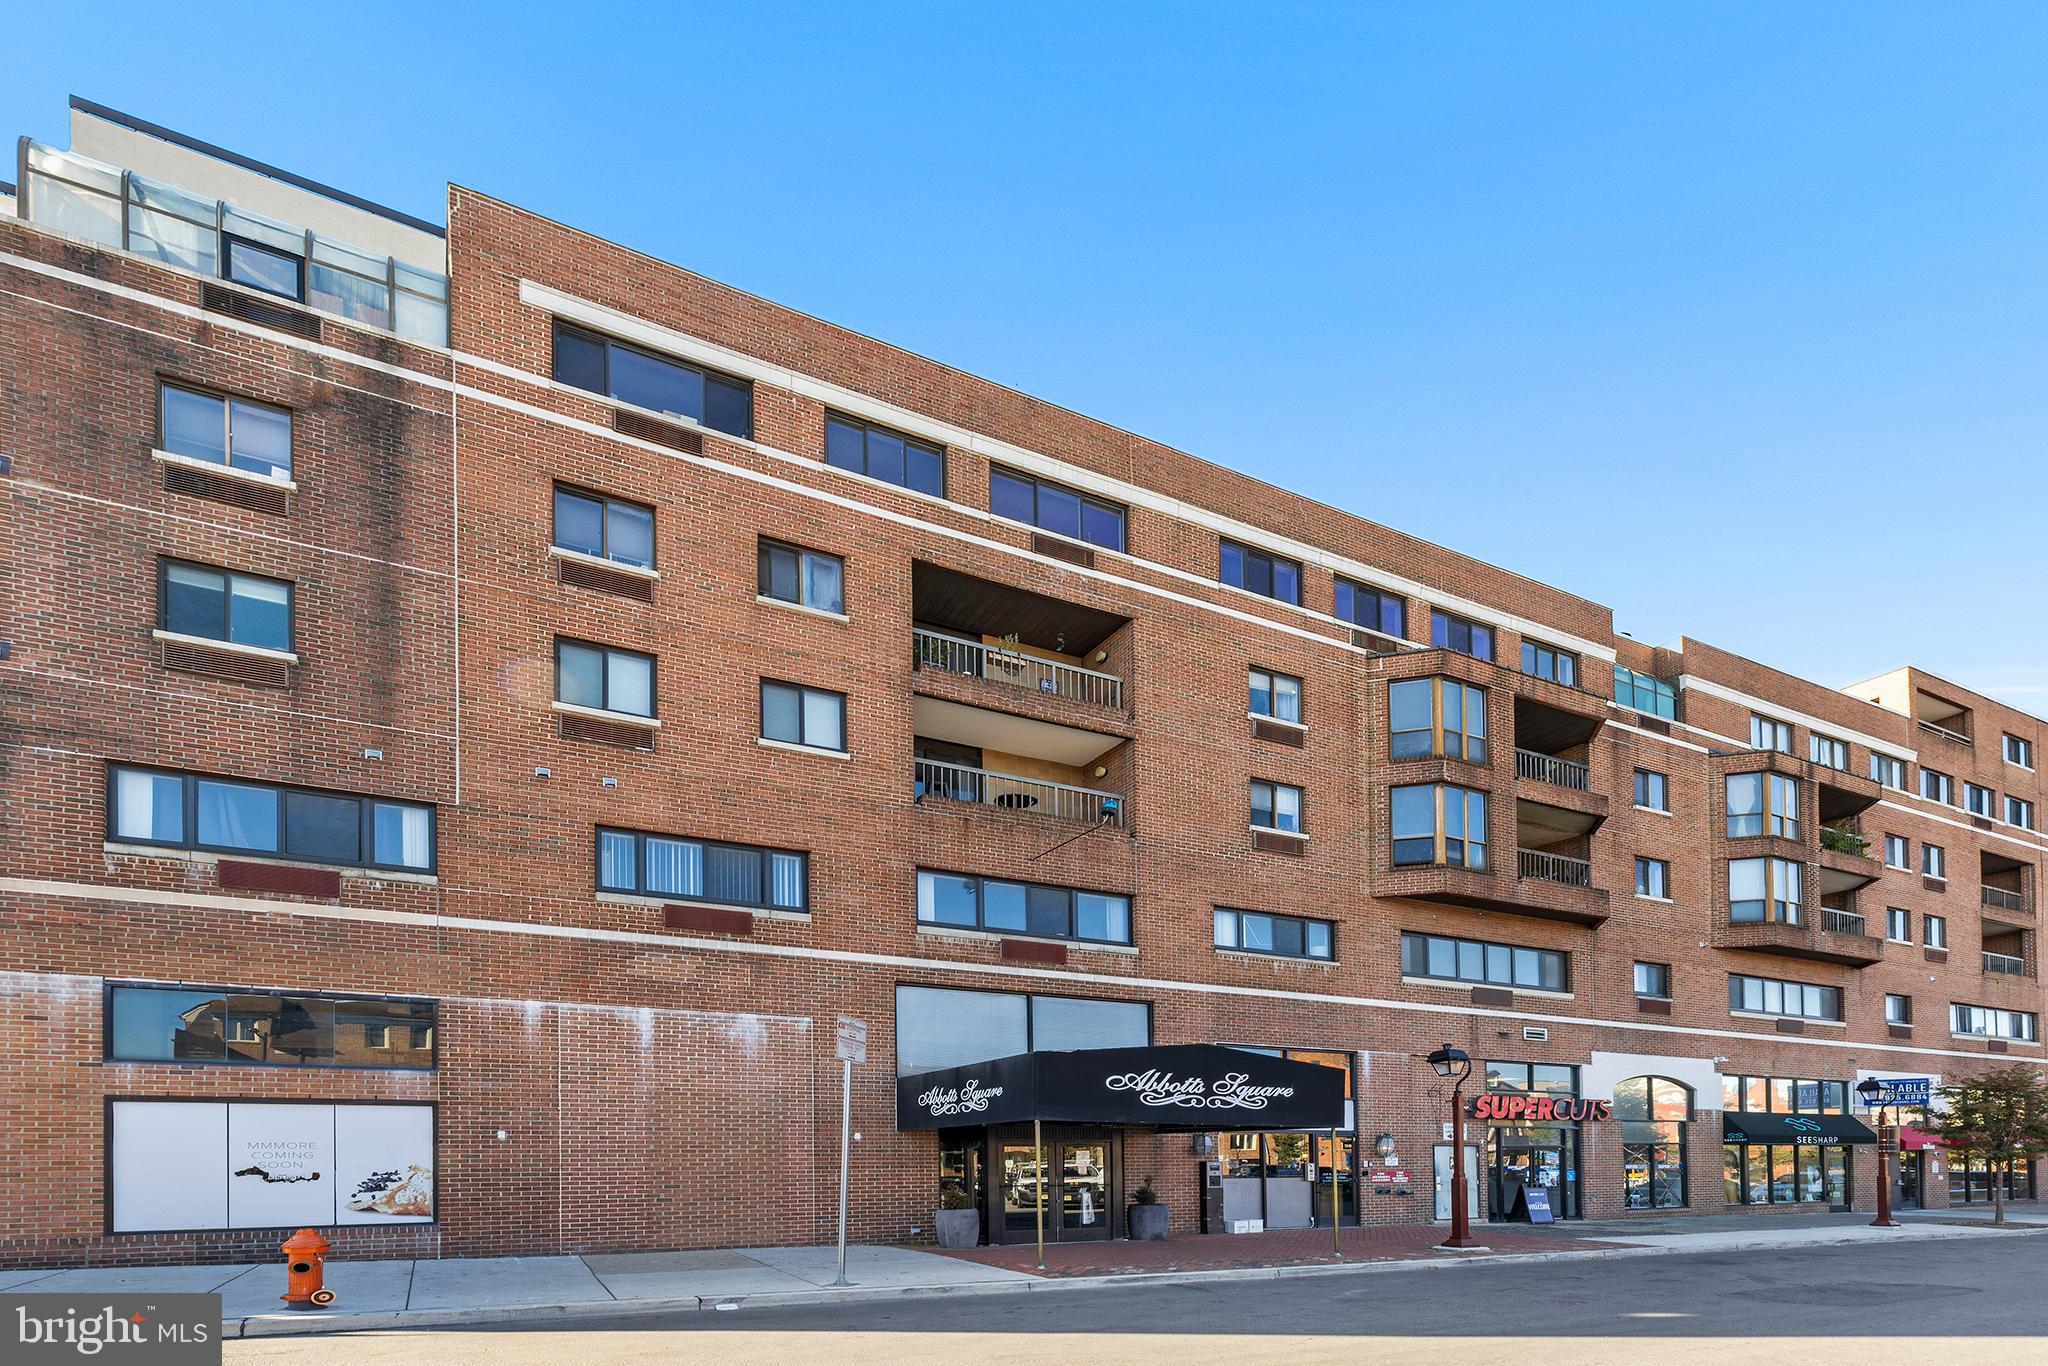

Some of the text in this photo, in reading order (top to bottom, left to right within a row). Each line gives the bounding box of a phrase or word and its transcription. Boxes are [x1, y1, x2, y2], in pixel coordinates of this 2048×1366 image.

[960, 1080, 1003, 1110] Square
[1212, 1072, 1294, 1107] Square
[1475, 1094, 1612, 1121] SUPERCUTS
[248, 1142, 316, 1150] MMMORE
[1796, 1136, 1839, 1144] SEESHARP
